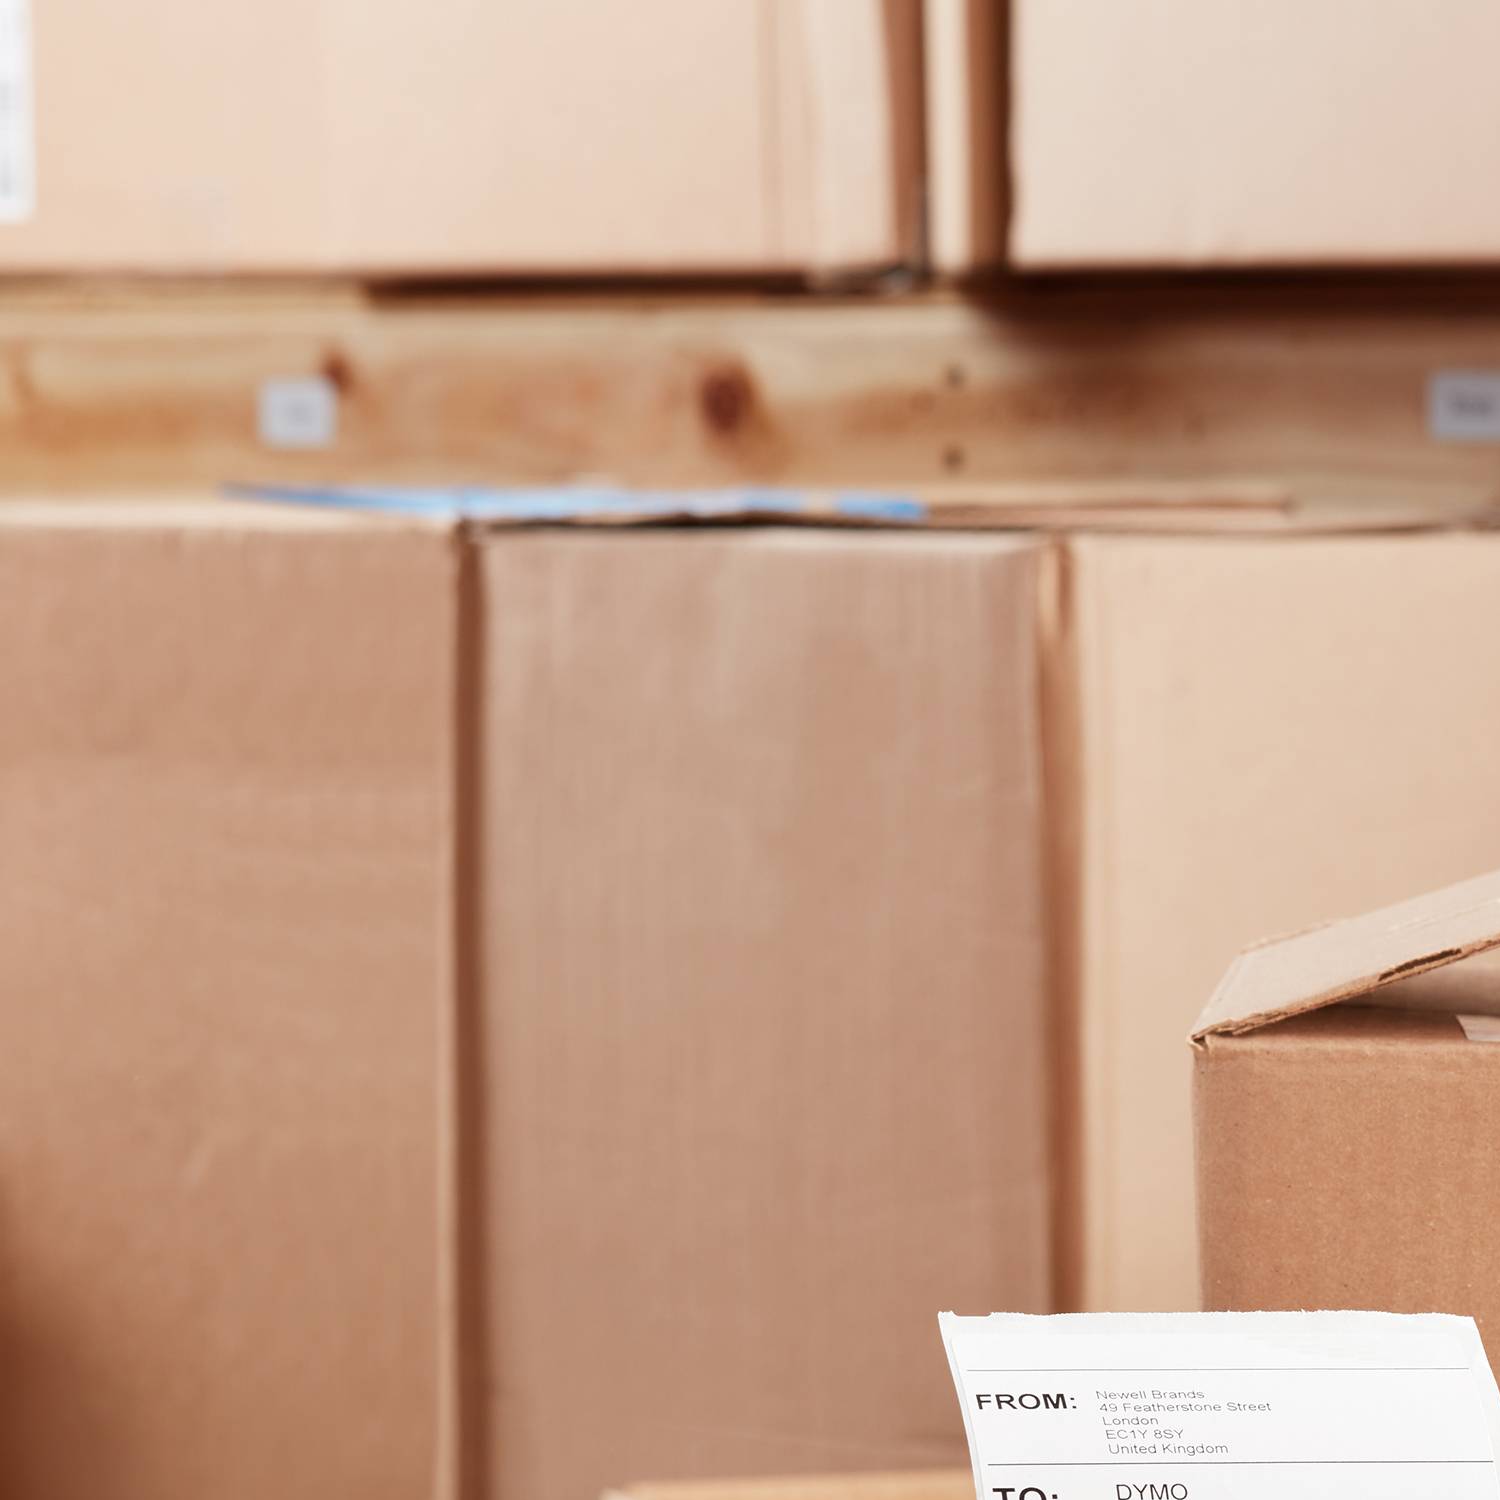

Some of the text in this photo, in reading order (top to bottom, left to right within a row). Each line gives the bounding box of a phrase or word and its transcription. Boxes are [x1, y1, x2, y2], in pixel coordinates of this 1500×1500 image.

[1095, 1389, 1205, 1400] Newell Brands
[975, 1392, 1078, 1411] FROM:
[1099, 1401, 1272, 1413] 49 Featherstone Street
[1101, 1415, 1159, 1426] London
[1104, 1428, 1184, 1441] EC1Y 8SY
[1108, 1442, 1229, 1457] United Kingdom
